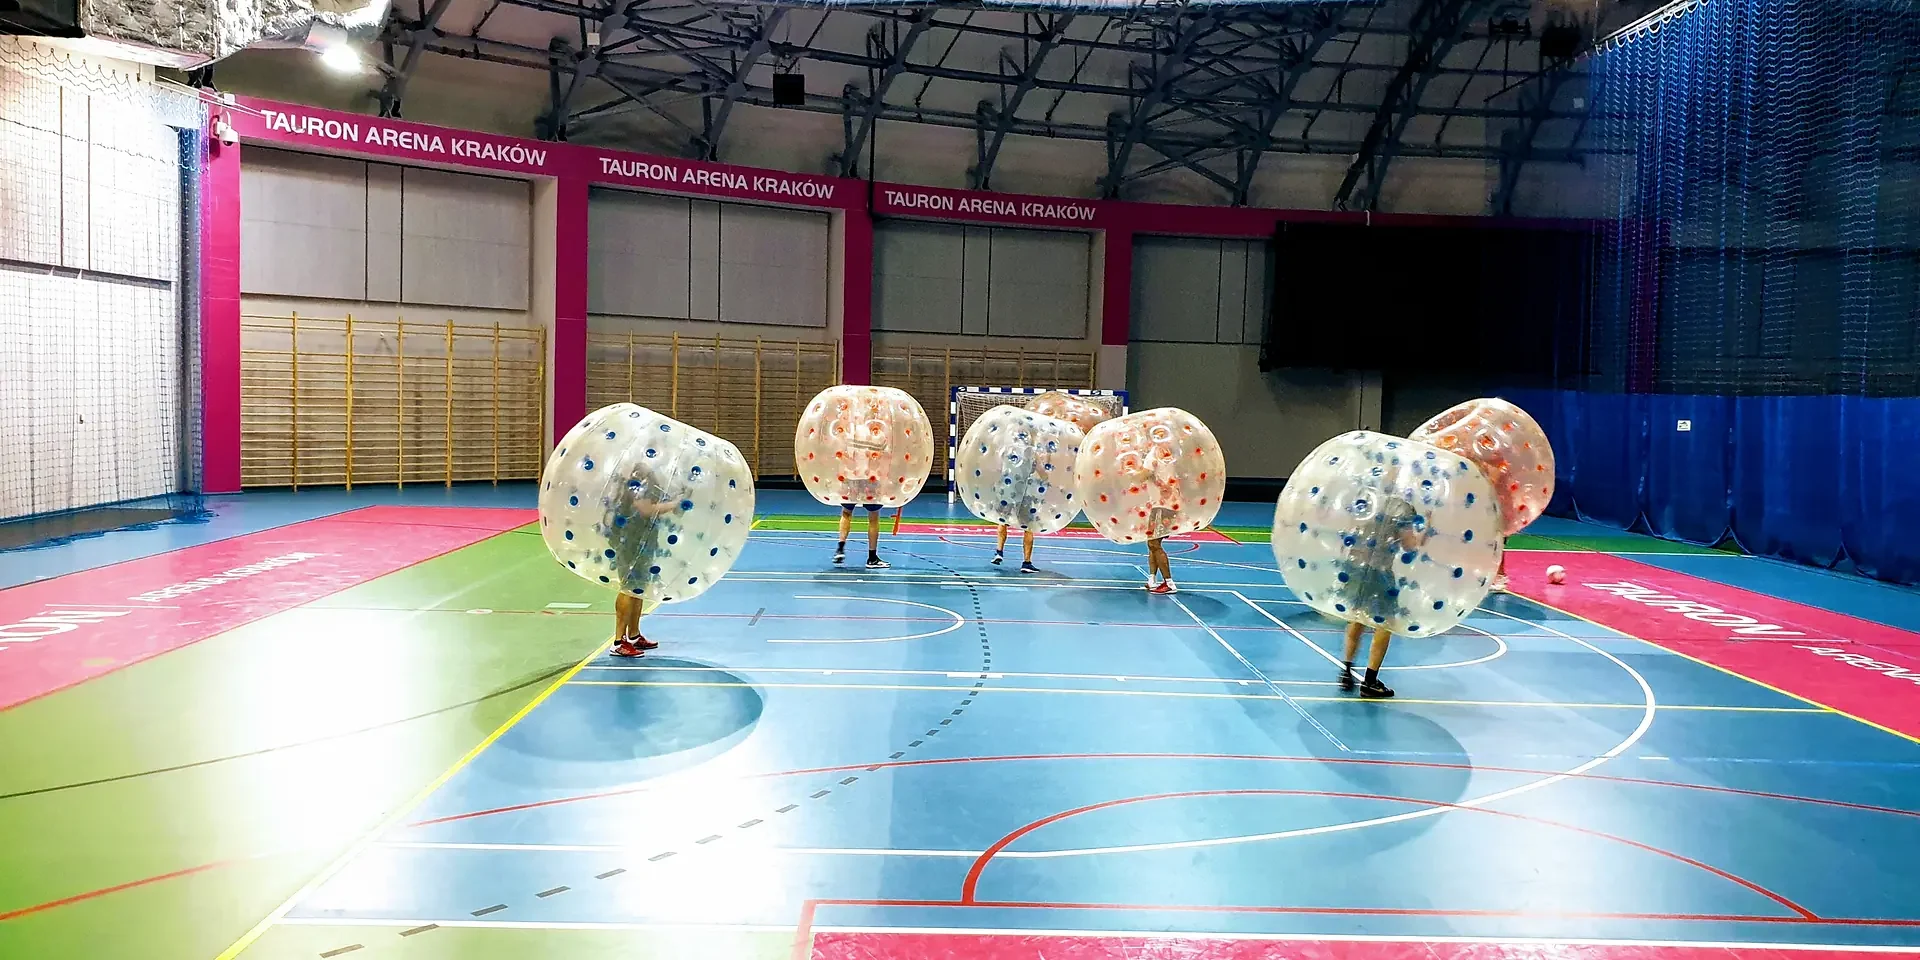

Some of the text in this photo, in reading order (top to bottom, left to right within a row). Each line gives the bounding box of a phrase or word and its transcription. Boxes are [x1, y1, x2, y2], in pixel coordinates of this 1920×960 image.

[260, 109, 547, 167] TAURON ARENA KRAKÓW
[599, 157, 834, 199] TAURON ARENA KRAKÓW
[885, 190, 1096, 221] TAURON ARENA KRAKÓW
[1582, 580, 1806, 636] TAURON
